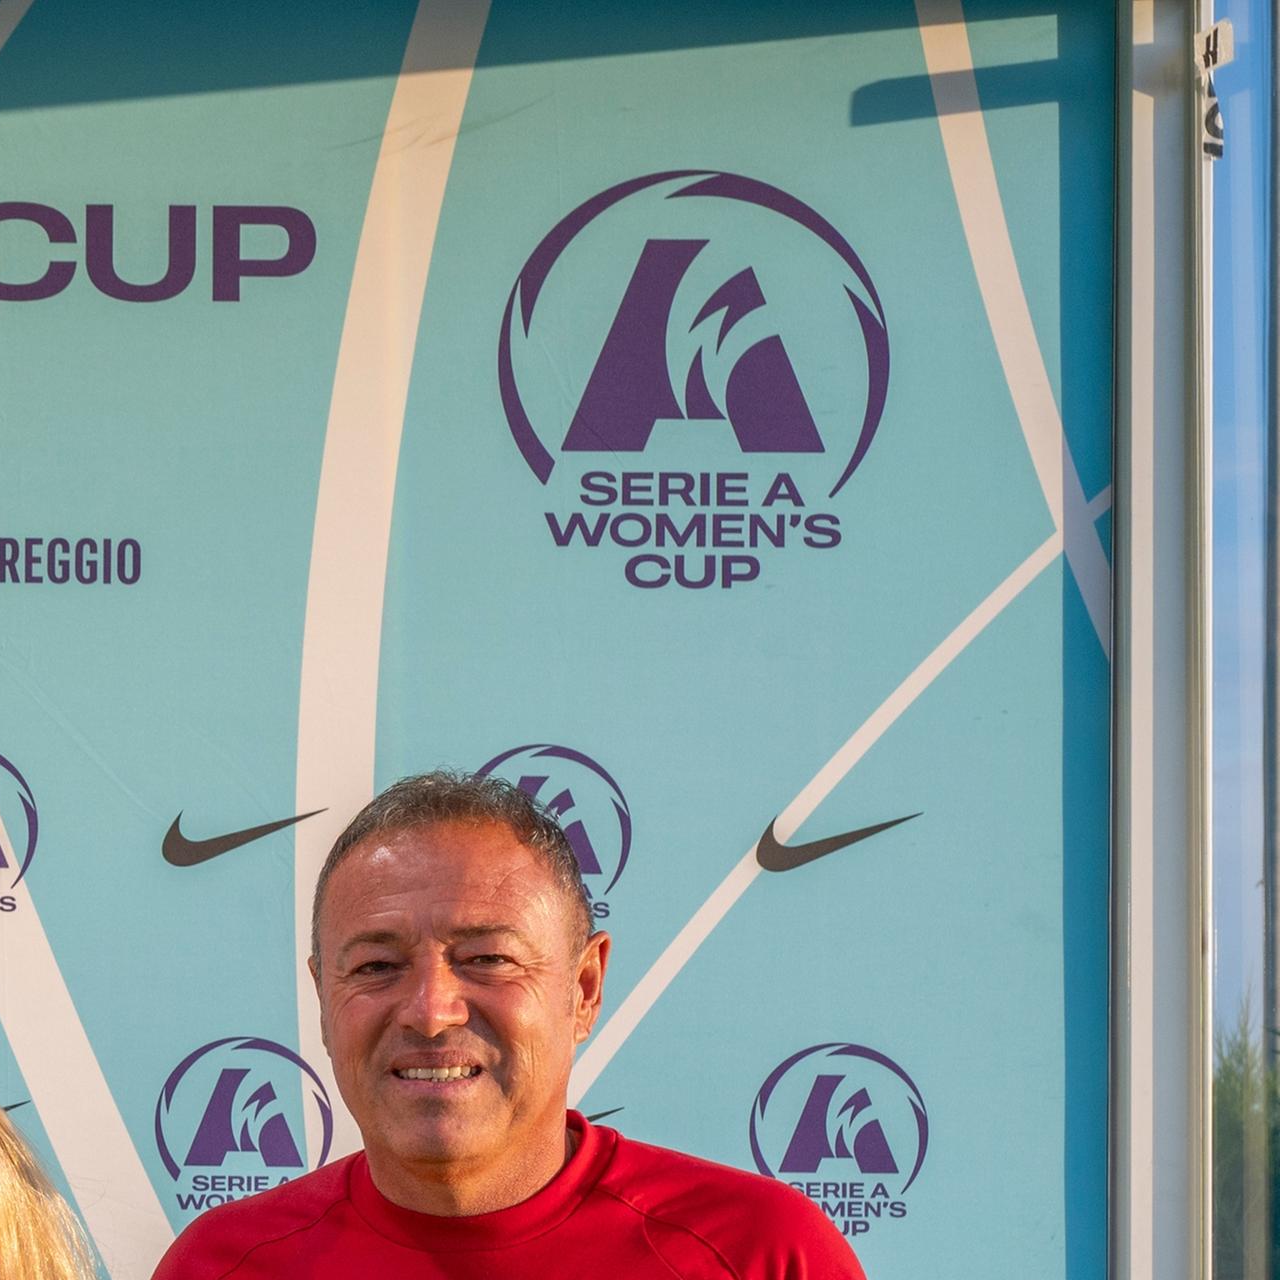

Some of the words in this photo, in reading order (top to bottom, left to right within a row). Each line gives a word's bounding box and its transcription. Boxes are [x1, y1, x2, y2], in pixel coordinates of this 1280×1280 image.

[579, 471, 749, 507] SERIE
[761, 472, 805, 507] A
[544, 512, 842, 549] WOMEN'S
[624, 553, 761, 590] CUP
[192, 1175, 270, 1192] SERIE
[870, 1182, 890, 1199] A
[821, 1200, 907, 1218] MEN'S
